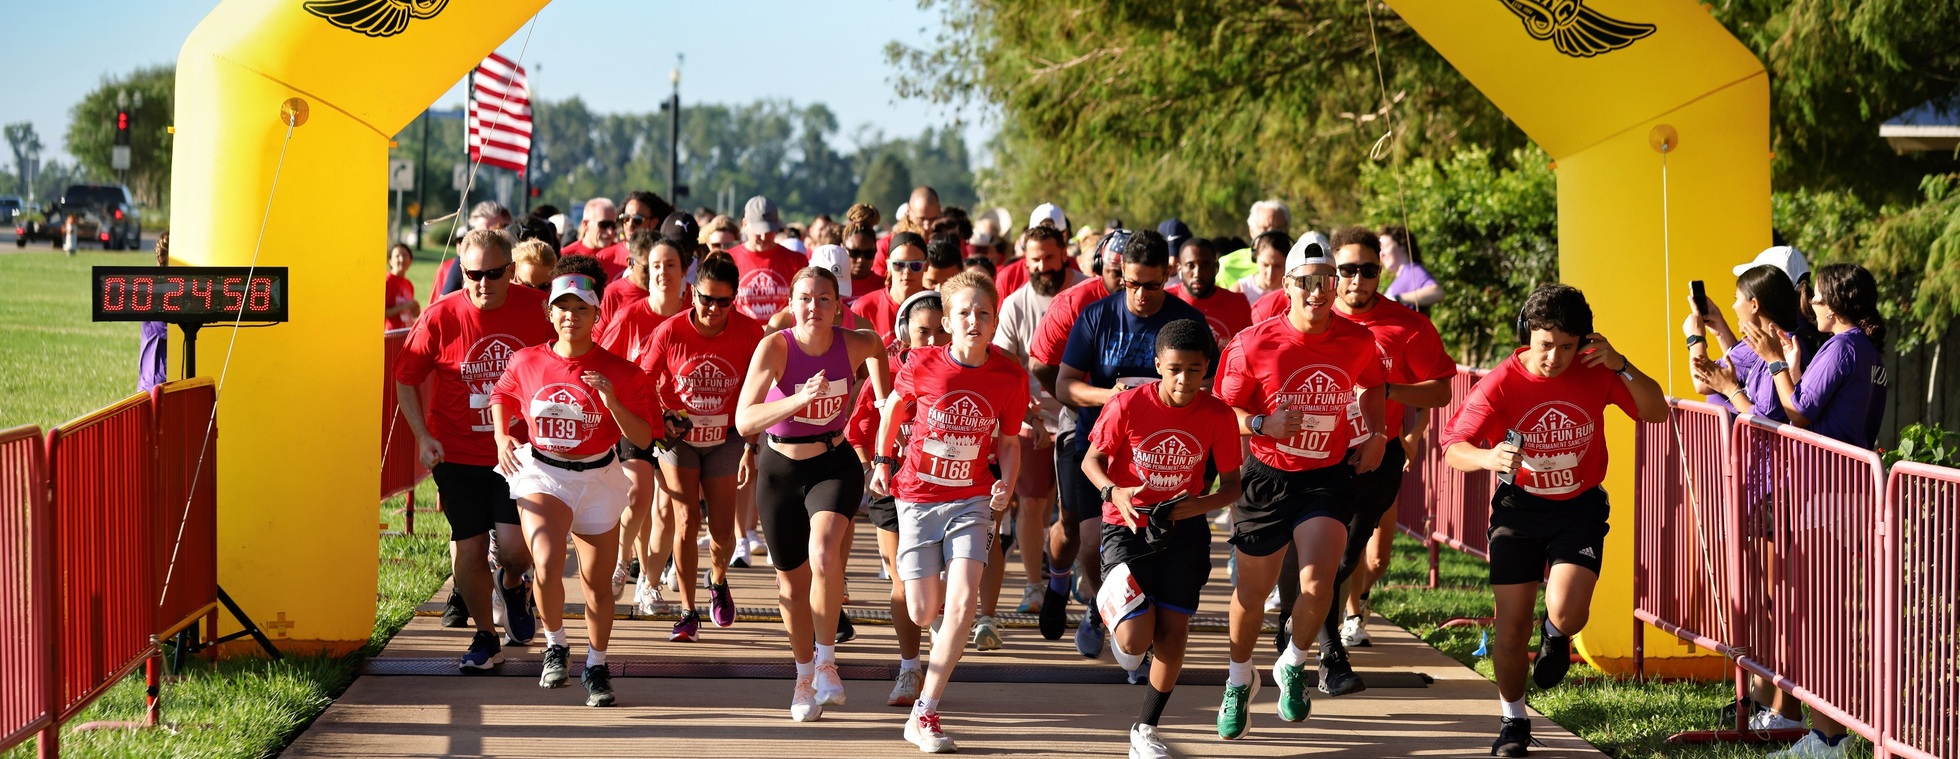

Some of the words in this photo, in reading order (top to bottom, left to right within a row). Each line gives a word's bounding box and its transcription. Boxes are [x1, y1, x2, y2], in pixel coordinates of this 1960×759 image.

[460, 361, 494, 375] FAMILY
[496, 359, 509, 371] FU
[705, 378, 723, 388] FUN
[725, 377, 740, 388] RUN
[806, 396, 843, 418] 1103
[1314, 392, 1336, 405] FUN
[1300, 404, 1329, 412] PERMANENT
[582, 413, 603, 424] RUN
[928, 407, 959, 425] FAMILY
[960, 416, 979, 428] FUN
[979, 417, 996, 428] RUN
[536, 417, 577, 439] 1139
[690, 427, 723, 442] 1150
[1522, 431, 1549, 444] MILY
[1551, 429, 1573, 443] FUN
[1575, 421, 1595, 439] RUN
[1289, 430, 1331, 451] 1107
[1535, 441, 1567, 450] PERMANENT
[1132, 447, 1166, 465] FAMILY
[1166, 455, 1187, 466] FUN
[930, 456, 971, 480] 1168
[1142, 461, 1152, 469] FOR
[1152, 463, 1179, 471] PERMANENT
[1530, 469, 1575, 488] 1109
